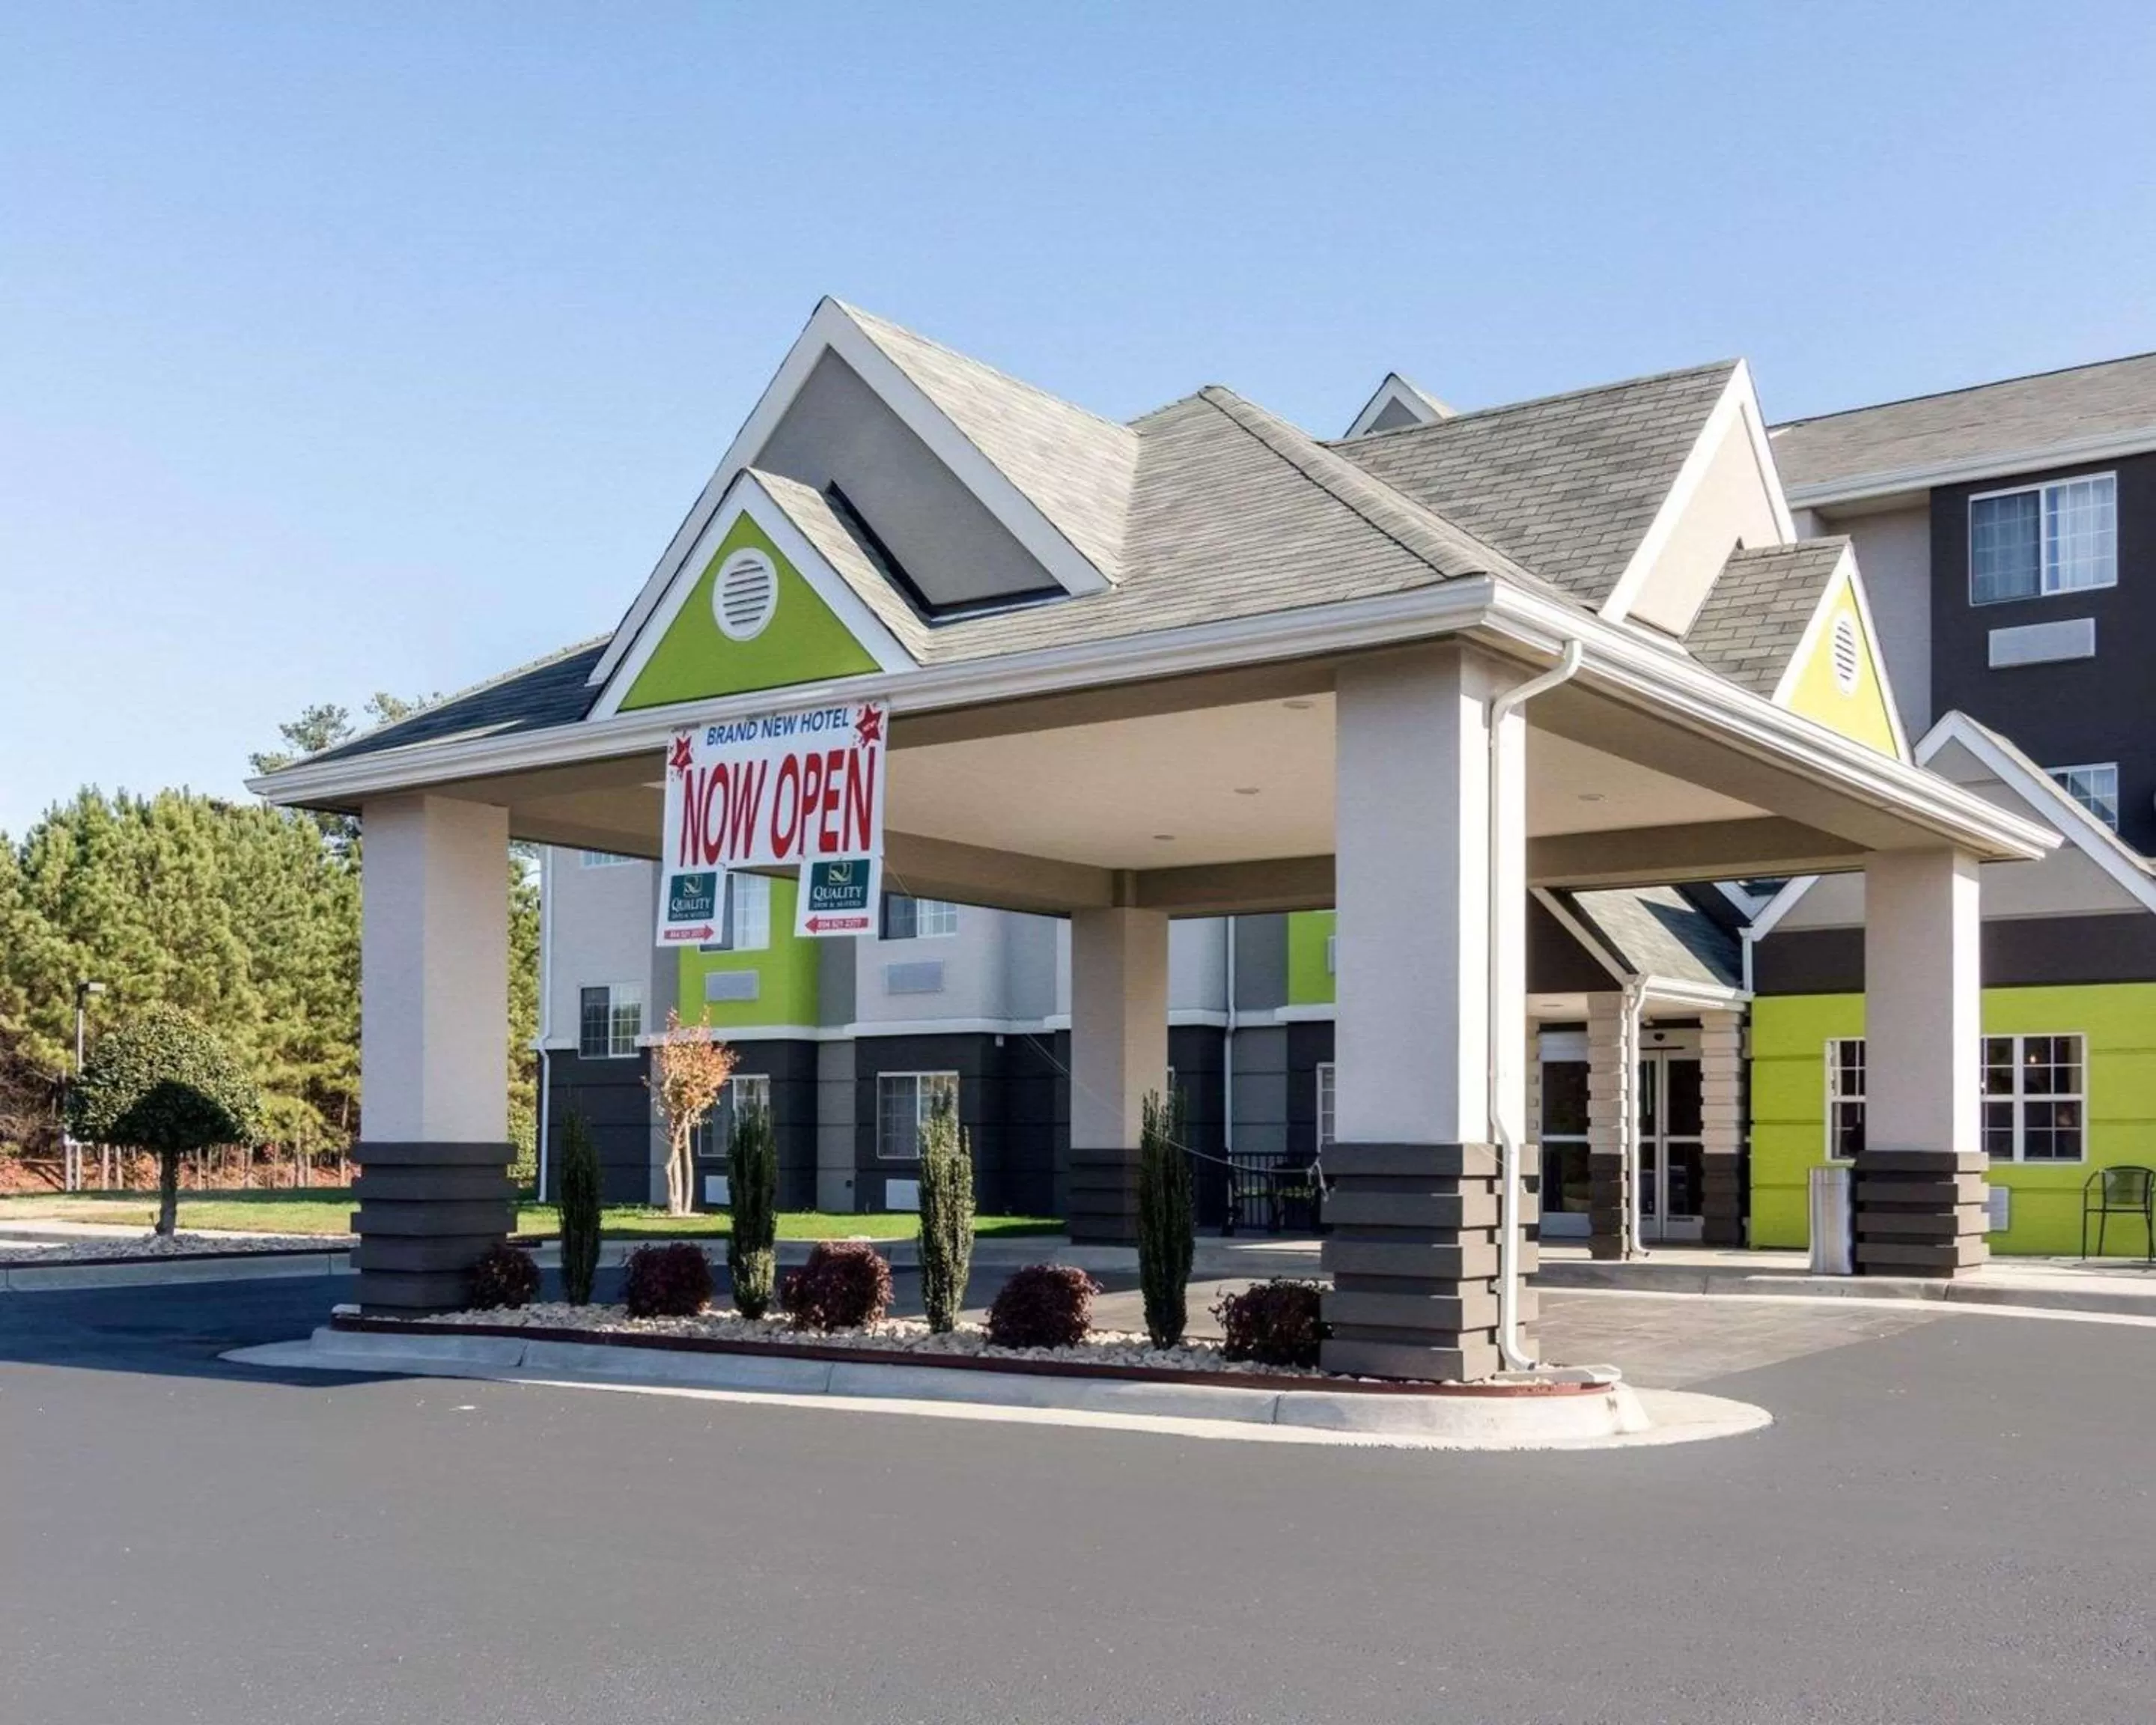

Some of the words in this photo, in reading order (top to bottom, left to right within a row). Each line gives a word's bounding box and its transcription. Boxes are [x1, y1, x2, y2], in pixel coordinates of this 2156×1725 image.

[707, 721, 758, 746] BRAND
[761, 714, 798, 739] NEW
[800, 708, 850, 733] HOTEL
[680, 759, 768, 868] NOW
[770, 746, 876, 859] OPEN
[671, 897, 712, 913] QUALITY
[813, 885, 863, 901] QUALITY
